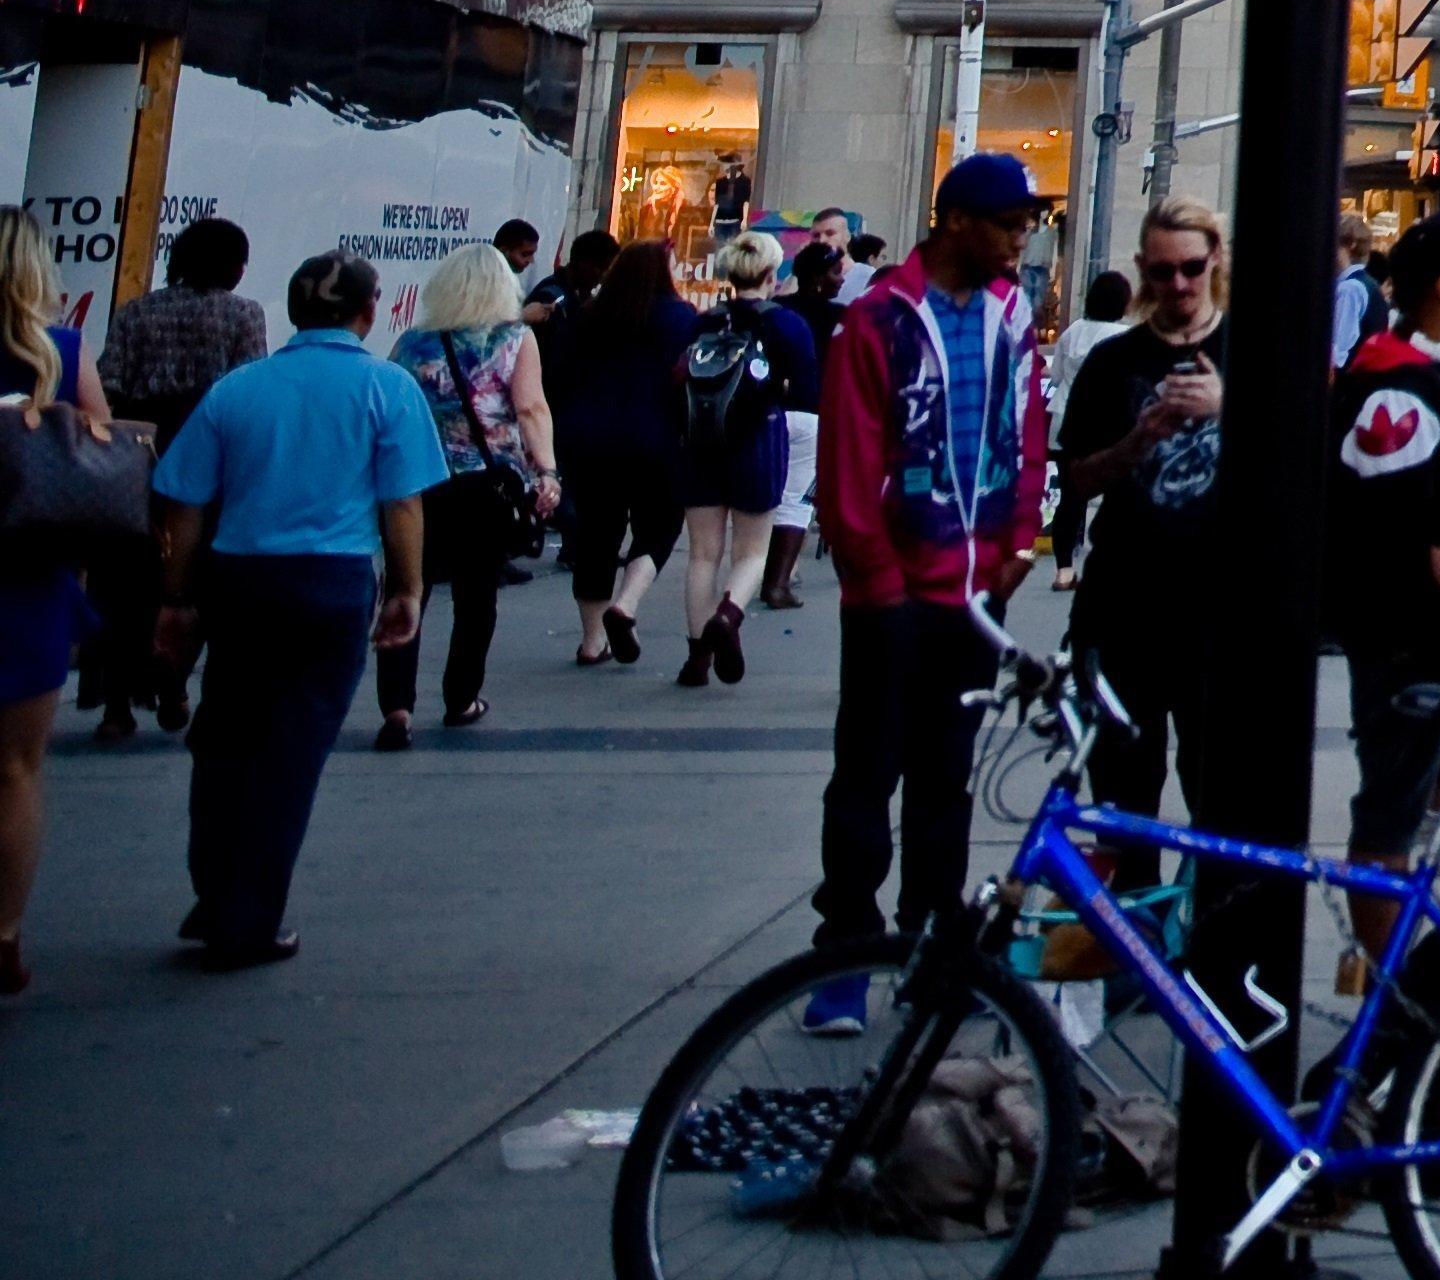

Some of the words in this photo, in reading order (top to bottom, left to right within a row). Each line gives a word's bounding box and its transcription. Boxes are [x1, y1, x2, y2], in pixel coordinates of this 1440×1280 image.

[45, 197, 101, 225] TO
[383, 204, 415, 227] WE'RE
[417, 205, 438, 229] STILL
[441, 207, 469, 231] OPEN!
[338, 235, 382, 259] FASHION
[384, 236, 437, 260] MAKEOVER
[439, 239, 450, 260] IN
